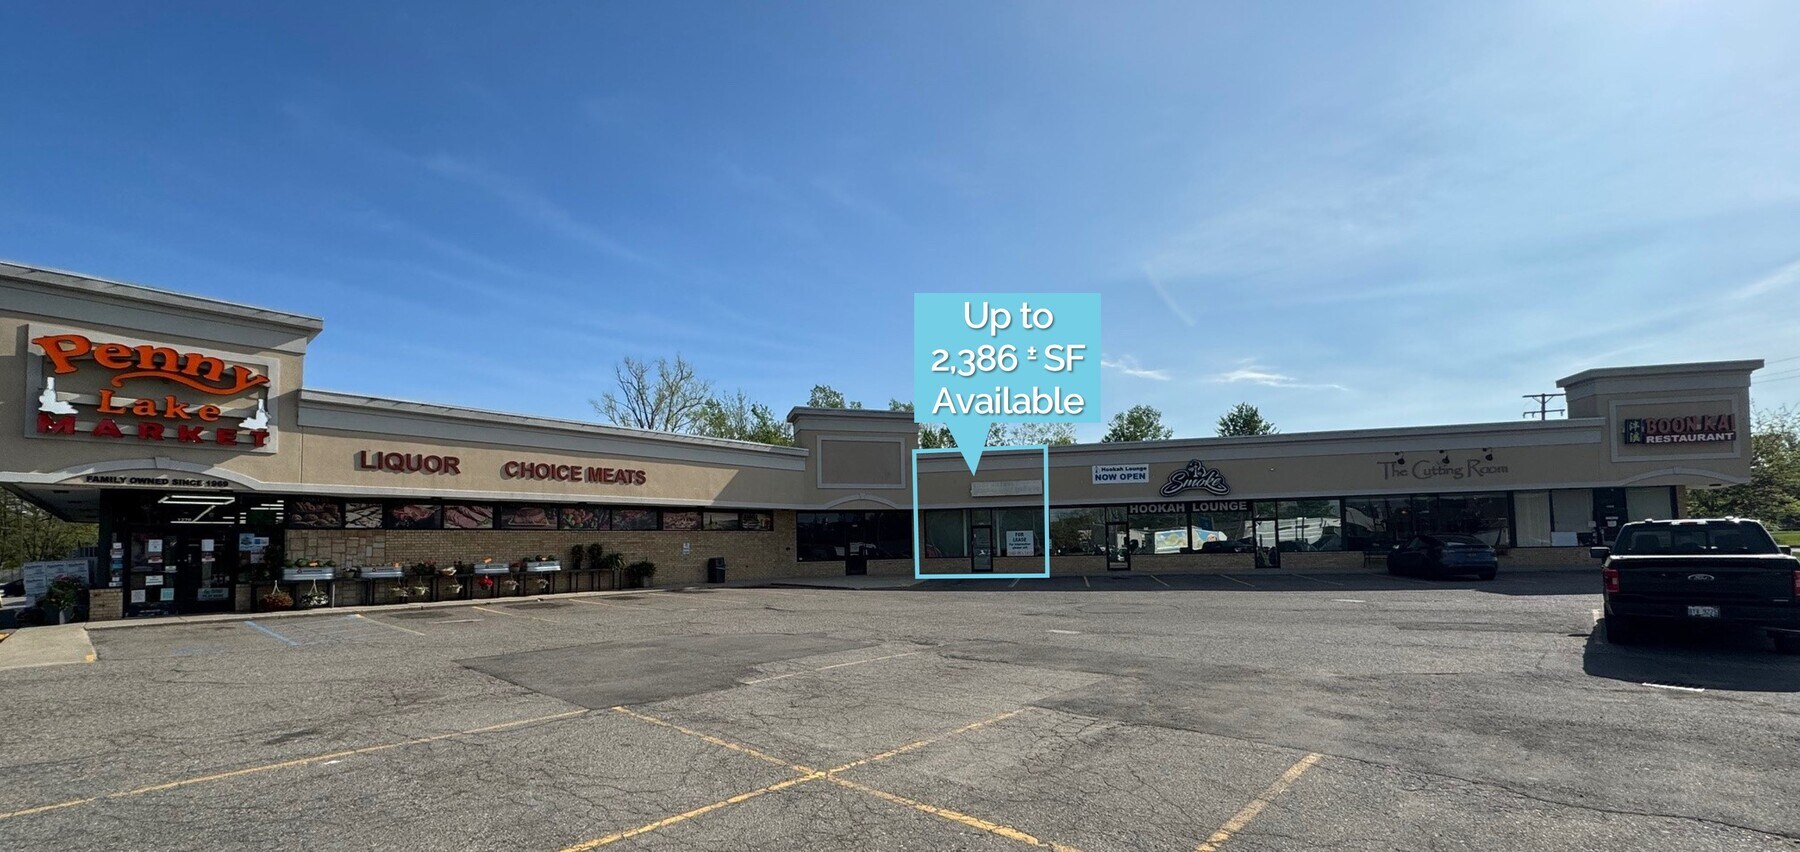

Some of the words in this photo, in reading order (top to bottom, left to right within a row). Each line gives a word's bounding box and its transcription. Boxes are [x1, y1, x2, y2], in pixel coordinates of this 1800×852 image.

[32, 334, 270, 395] Penny
[97, 389, 221, 422] Lake
[37, 413, 270, 447] MARKET
[1646, 432, 1734, 444] RESTAURANT
[359, 449, 461, 475] LIQUOR
[504, 460, 582, 482] CHOICE
[588, 466, 647, 486] MEATS
[1377, 461, 1408, 480] The
[1412, 460, 1463, 480] Cutting
[1467, 459, 1508, 477] Room
[86, 476, 127, 484] FAMILY
[129, 477, 169, 485] OWNED
[172, 478, 203, 486] SINCE
[1160, 472, 1230, 495] Smoke
[1129, 504, 1185, 513] HOOKAH
[1192, 502, 1247, 512] LOUNGE
